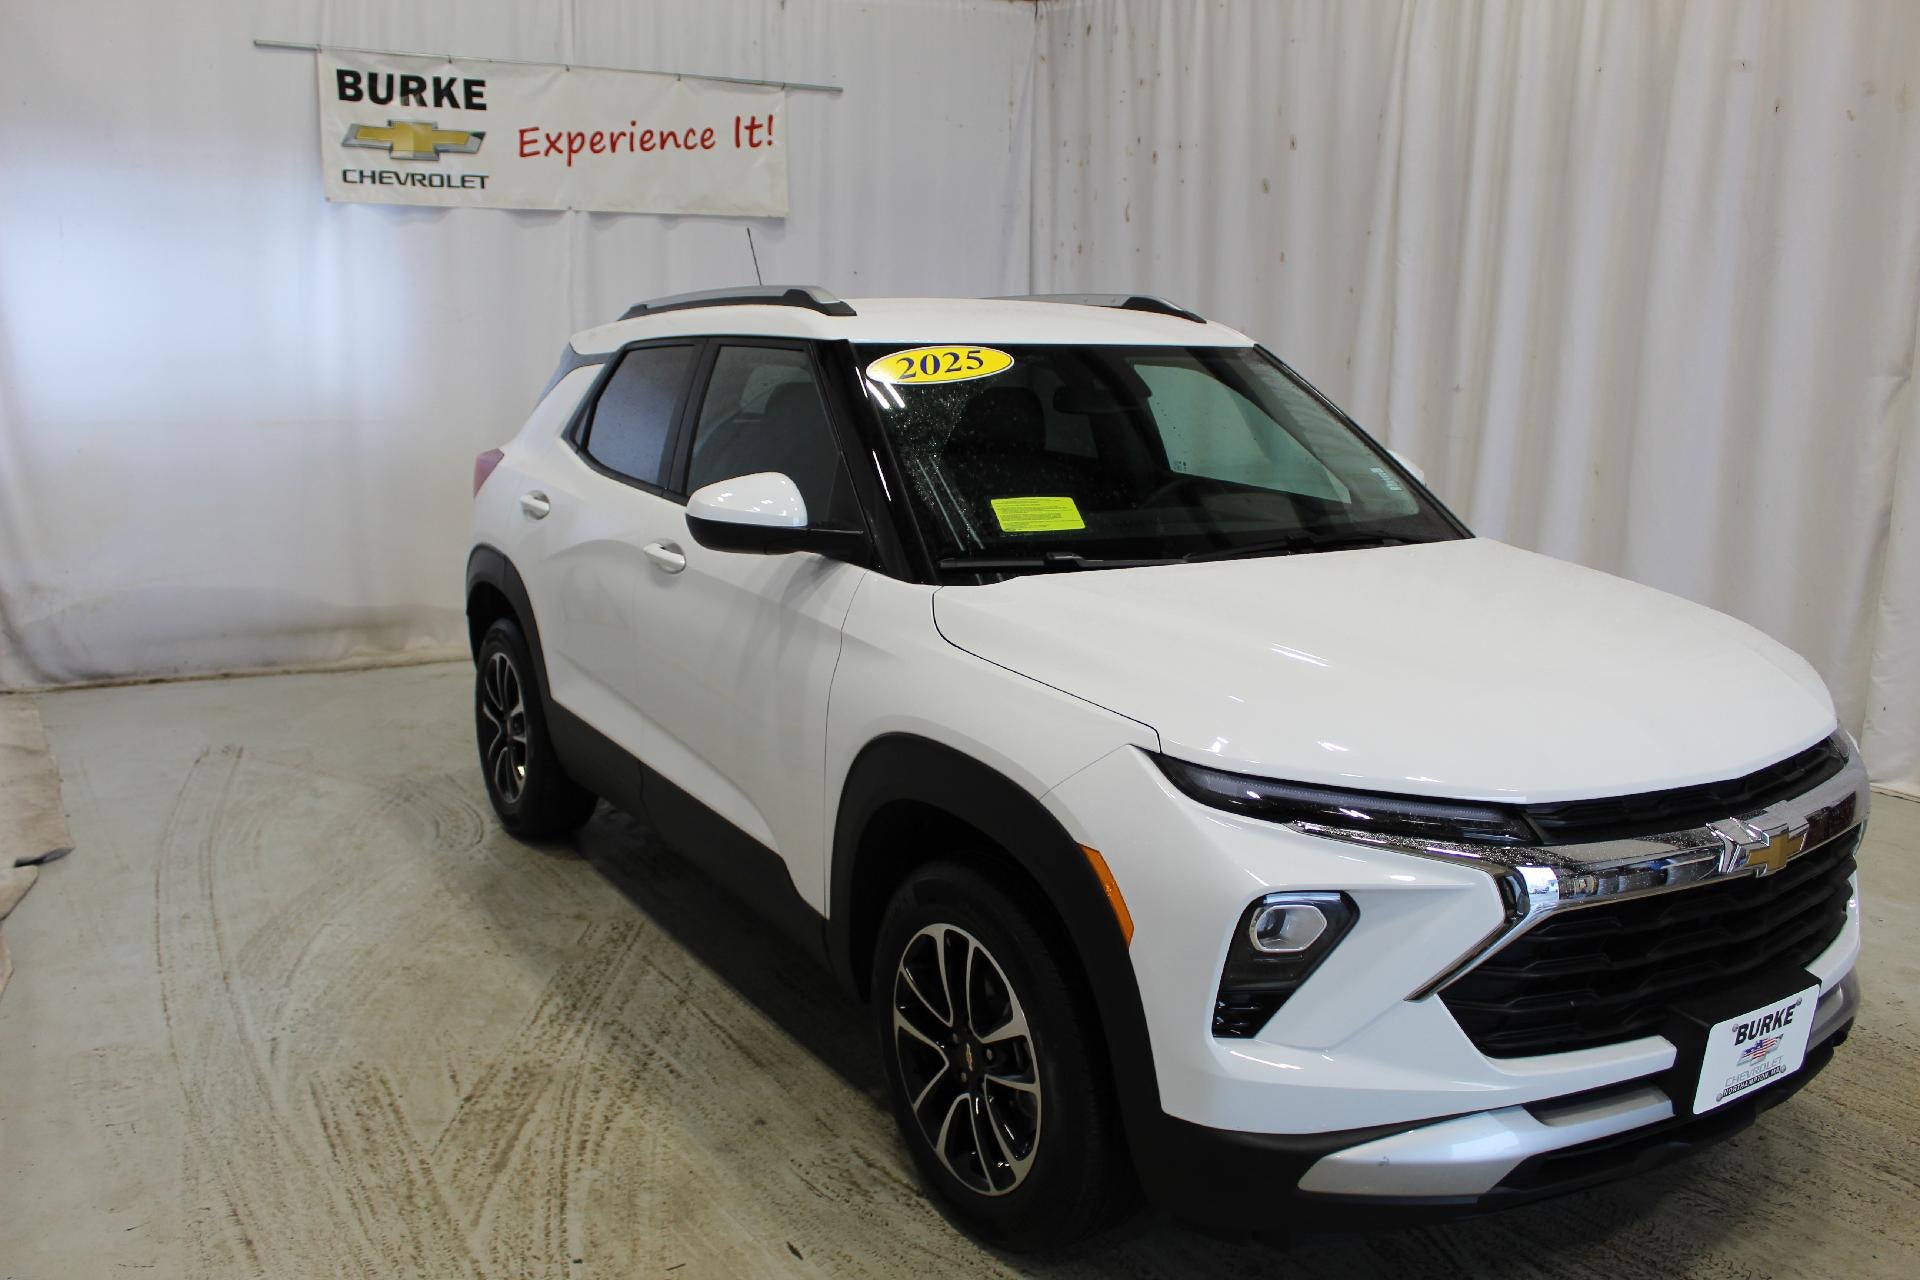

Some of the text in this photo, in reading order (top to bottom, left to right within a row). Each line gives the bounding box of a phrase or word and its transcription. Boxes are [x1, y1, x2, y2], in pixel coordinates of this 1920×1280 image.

[336, 69, 487, 111] BURKE
[518, 115, 775, 167] Experience It!
[342, 169, 490, 189] CHEVROLET
[896, 350, 984, 379] 2025
[1734, 1003, 1796, 1046] BURKE
[1724, 1055, 1784, 1087] CHEVROLET
